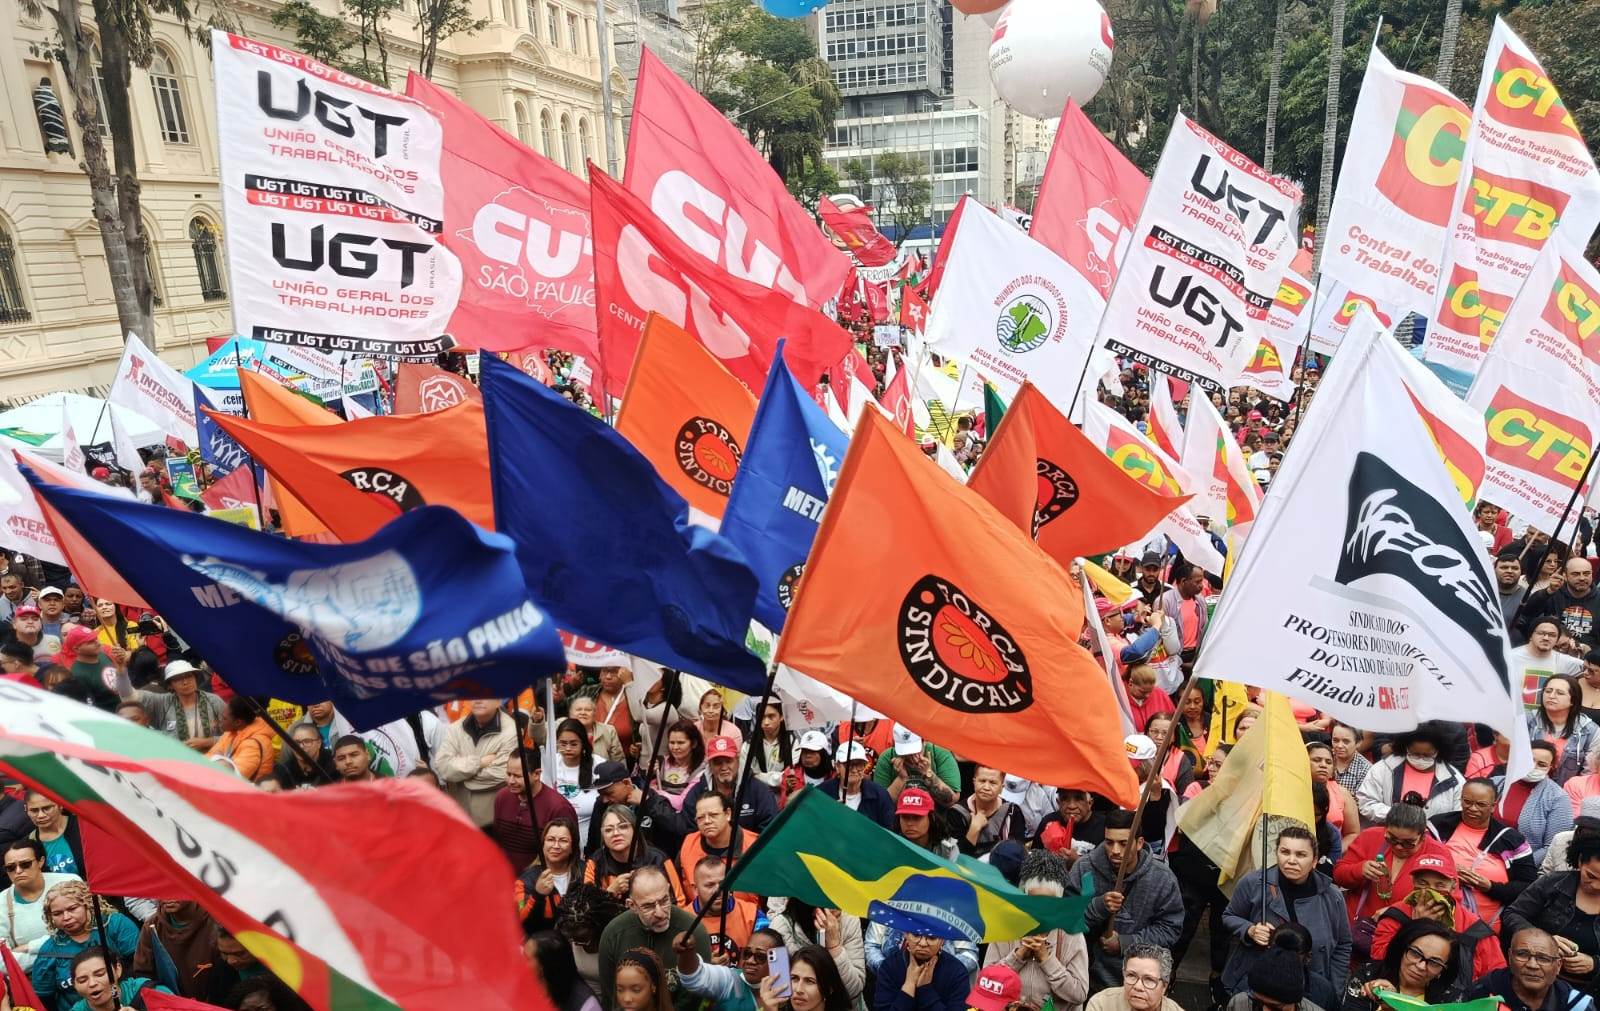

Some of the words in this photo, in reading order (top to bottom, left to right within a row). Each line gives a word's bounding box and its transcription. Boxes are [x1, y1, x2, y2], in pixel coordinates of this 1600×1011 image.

[239, 40, 268, 57] UGT
[273, 48, 301, 67] UGT
[305, 60, 334, 79] UGT
[258, 70, 410, 158] UGT
[263, 127, 316, 144] UNIÃO
[383, 164, 419, 182] DOS
[1230, 153, 1250, 170] UGT
[1479, 131, 1541, 161] Trabalhadoras
[1542, 156, 1555, 166] do
[1557, 161, 1588, 177] Brasil
[1508, 135, 1525, 146] dos
[1528, 141, 1594, 170] Trabalhadores
[256, 178, 287, 193] UGT
[291, 183, 319, 197] UGT
[324, 186, 352, 202] UGT
[356, 193, 383, 207] UGT
[412, 216, 437, 233] UGT
[258, 193, 289, 207] UGT
[294, 198, 322, 211] UGT
[327, 200, 355, 215] UGT
[360, 206, 387, 220] UGT
[1191, 154, 1285, 245] UGT
[473, 203, 595, 280] CU
[1348, 225, 1411, 265] Central
[1457, 223, 1473, 232] Cen
[1462, 233, 1476, 241] Tra
[271, 222, 434, 290] UGT
[1152, 240, 1175, 257] UGT
[1176, 251, 1197, 267] UGT
[1199, 261, 1220, 277] UGT
[1221, 273, 1239, 290] UGT
[1249, 244, 1276, 262] DOS
[1340, 243, 1351, 255] e
[1497, 262, 1509, 271] do
[478, 263, 529, 299] SÃO
[1158, 230, 1181, 247] UGT
[1181, 242, 1204, 258] UGT
[1204, 254, 1225, 269] UGT
[1226, 265, 1244, 282] UGT
[1251, 294, 1268, 307] UGT
[272, 279, 328, 296] UNIÃO
[336, 289, 393, 303] GERAL
[401, 294, 434, 306] DOS
[278, 294, 429, 319] TRABALHADORES
[616, 224, 752, 361] CU
[994, 278, 1021, 307] MOVIMENTO
[1020, 275, 1032, 286] DOS
[1033, 276, 1061, 300] ATINGIDOS
[1149, 265, 1244, 347] UGT
[1137, 306, 1171, 327] UNIÃO
[264, 330, 294, 343] UGT
[297, 334, 327, 347] UGT
[330, 337, 359, 350] UGT
[362, 341, 392, 353] UGT
[395, 344, 416, 354] UGT
[418, 339, 444, 352] UGT
[1430, 332, 1461, 345] Central
[1462, 341, 1479, 351] dos
[1530, 328, 1566, 350] Central
[998, 359, 1028, 379] ENERGIA
[1112, 342, 1131, 357] UGT
[1134, 353, 1154, 369] UGT
[1155, 361, 1178, 377] UGT
[1177, 369, 1199, 384] UGT
[1200, 379, 1221, 395] UGT
[1487, 408, 1590, 481] CTB
[352, 471, 408, 502] RÇA
[1486, 465, 1496, 473] al
[1497, 470, 1515, 482] dos
[783, 486, 828, 523] META
[1485, 474, 1531, 501] alhadoras
[1532, 500, 1544, 509] do
[1546, 506, 1576, 524] Brail
[779, 585, 794, 608] SIN
[367, 656, 406, 673] DE
[408, 638, 469, 671] SÃO
[468, 600, 544, 659] PAULO
[1348, 610, 1385, 633] SINDICATO
[1386, 619, 1410, 635] DOS
[905, 606, 1022, 707] SINDICAL
[1282, 613, 1368, 652] PROFESSORES
[1371, 637, 1381, 652] DO
[1400, 643, 1454, 690] OFICIAL
[1309, 648, 1340, 668] DO
[1341, 655, 1376, 675] ESTADO
[1285, 667, 1364, 707] Filiado
[1367, 686, 1376, 708] à
[980, 976, 1002, 994] CUT
